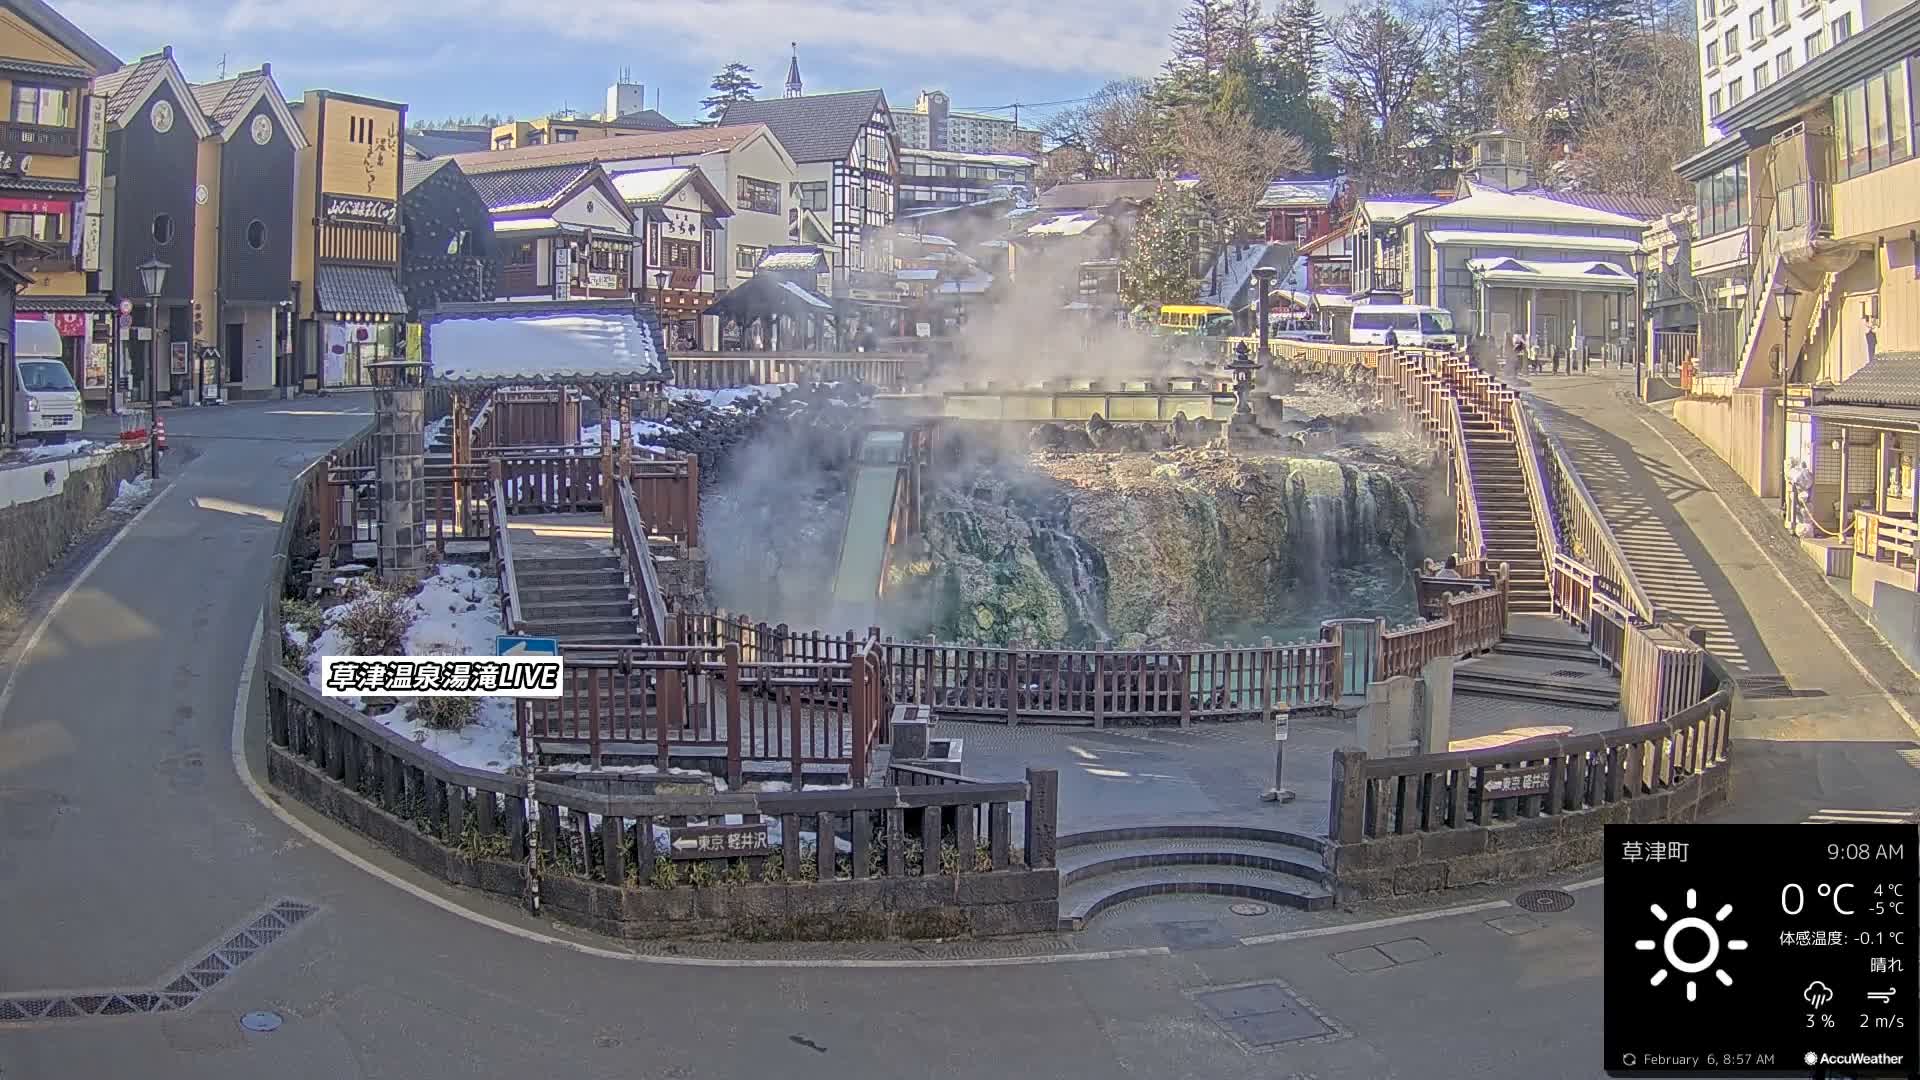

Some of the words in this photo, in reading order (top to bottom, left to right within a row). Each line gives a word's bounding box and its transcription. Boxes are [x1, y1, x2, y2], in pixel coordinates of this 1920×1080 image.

[698, 835, 724, 851] 東京
[728, 832, 767, 850] 軽井沢
